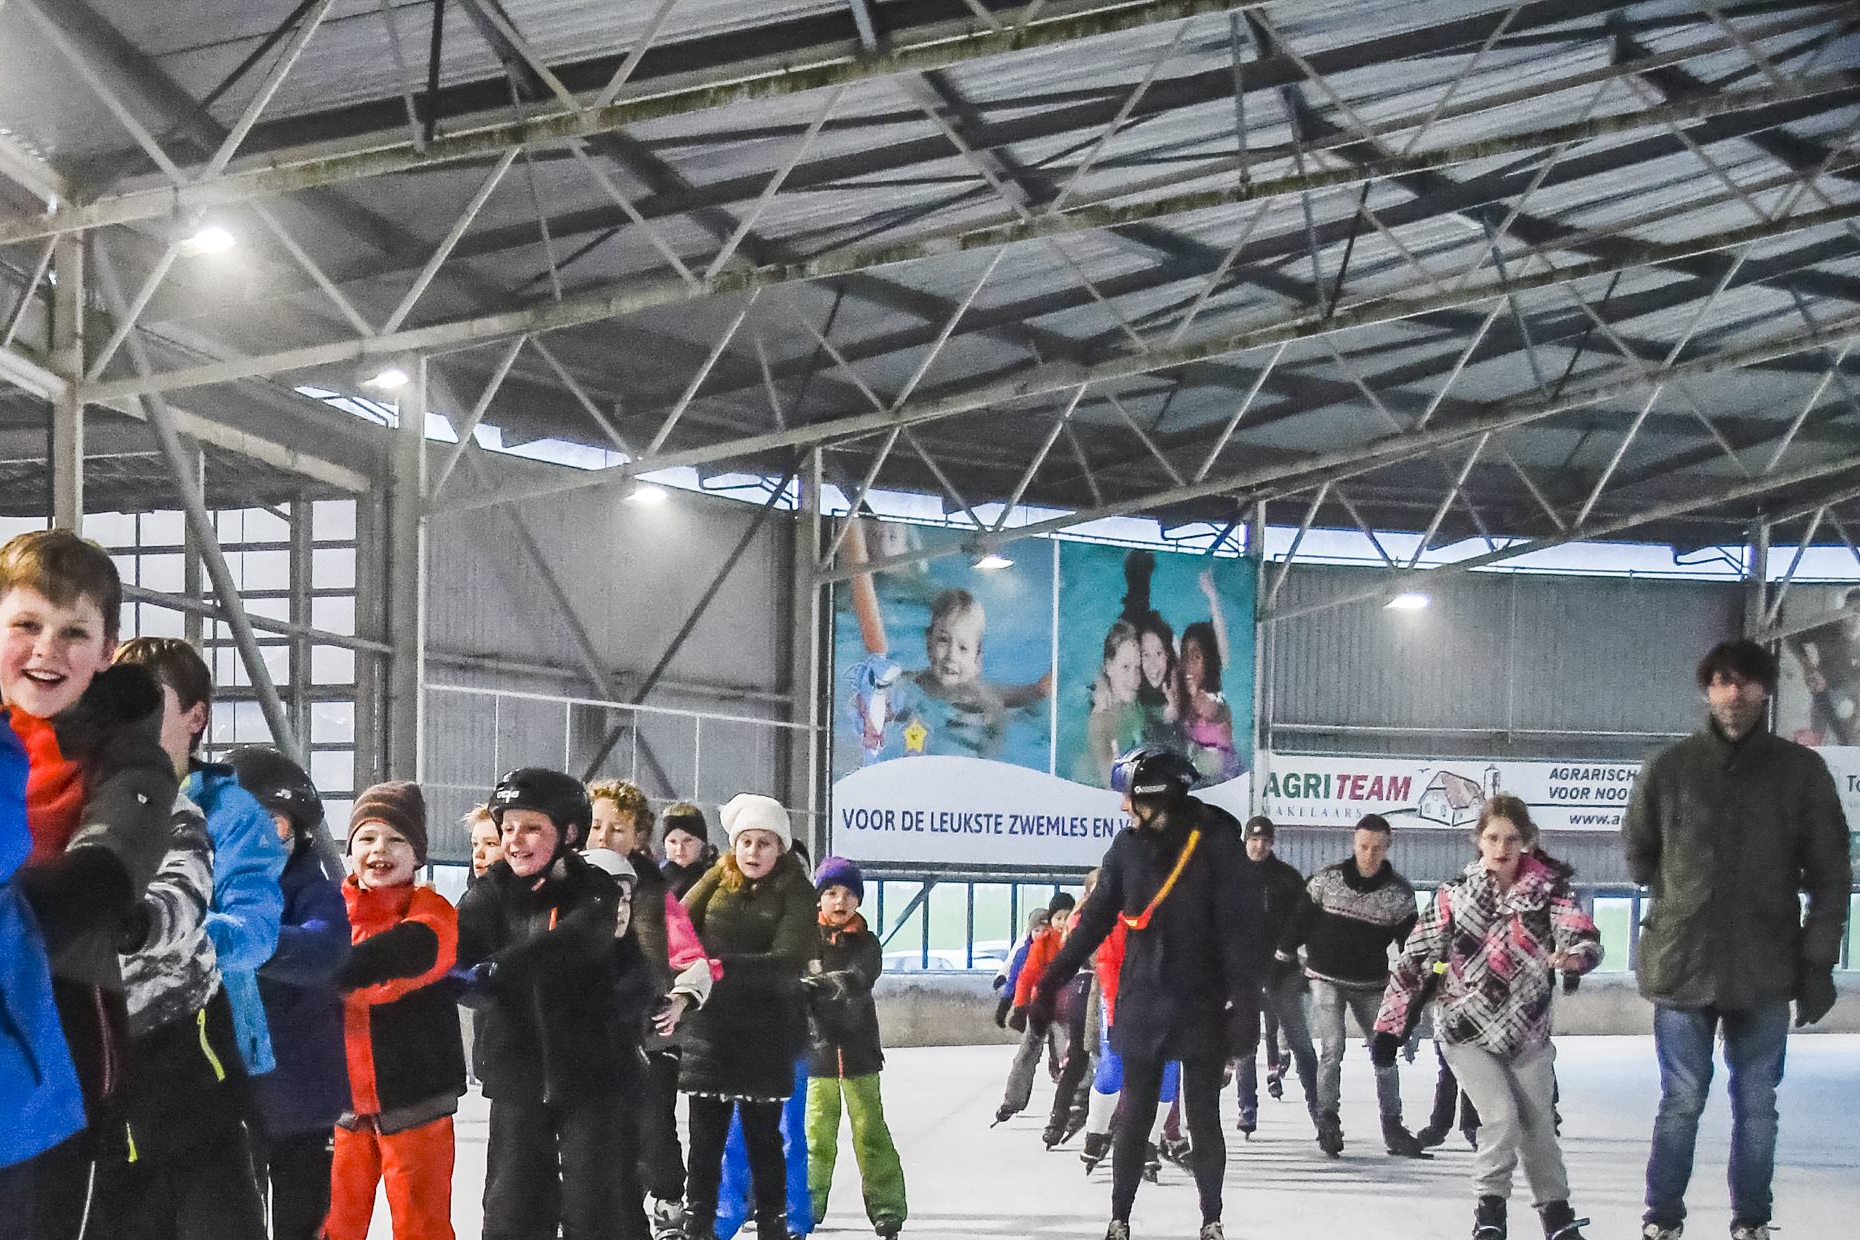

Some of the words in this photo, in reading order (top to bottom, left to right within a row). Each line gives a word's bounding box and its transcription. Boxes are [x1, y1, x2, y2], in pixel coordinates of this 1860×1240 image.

[1549, 767, 1638, 781] AGRARISCH
[1549, 786, 1591, 800] VOOR
[1594, 787, 1628, 801] NOO
[842, 808, 895, 831] VOOR
[901, 810, 924, 832] DE
[930, 811, 1003, 835] LEUKSTE
[1008, 814, 1088, 838] ZWEMLES
[1093, 817, 1114, 838] EN
[1569, 814, 1621, 825] www.a
